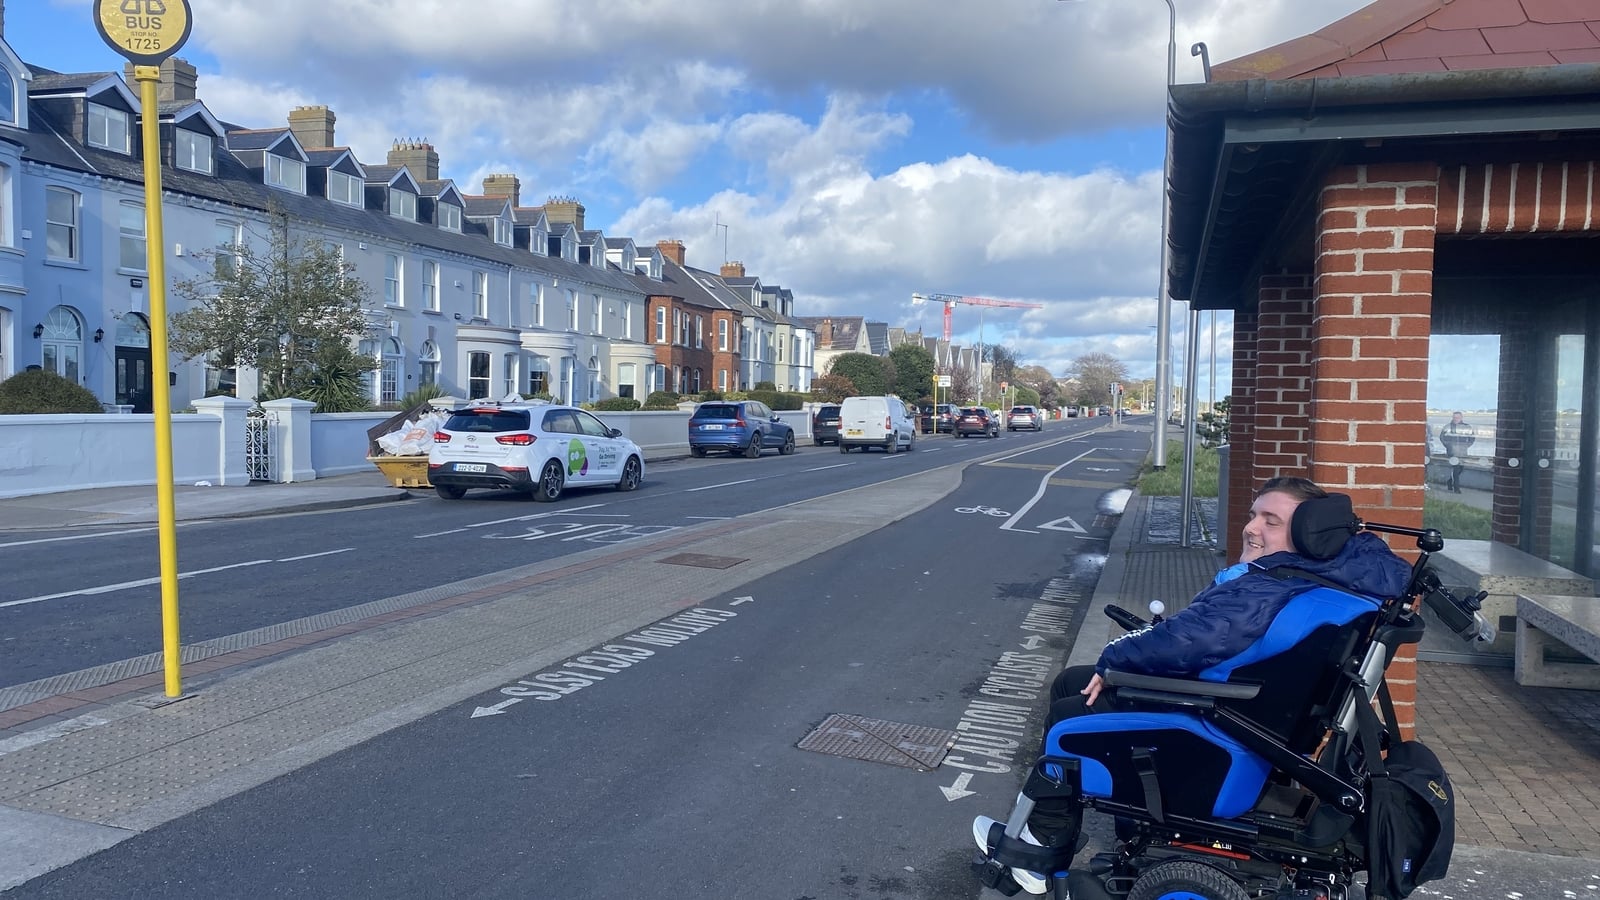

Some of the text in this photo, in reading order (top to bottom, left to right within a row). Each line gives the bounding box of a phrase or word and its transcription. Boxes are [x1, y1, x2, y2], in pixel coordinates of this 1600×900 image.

[126, 16, 162, 30] BUS
[125, 38, 161, 50] 1725
[480, 522, 682, 544] BUS
[1019, 602, 1074, 634] CAUTION
[500, 607, 738, 701] CAUTION CYCLISTS
[941, 651, 1053, 774] CAUTION CYCLISTS
